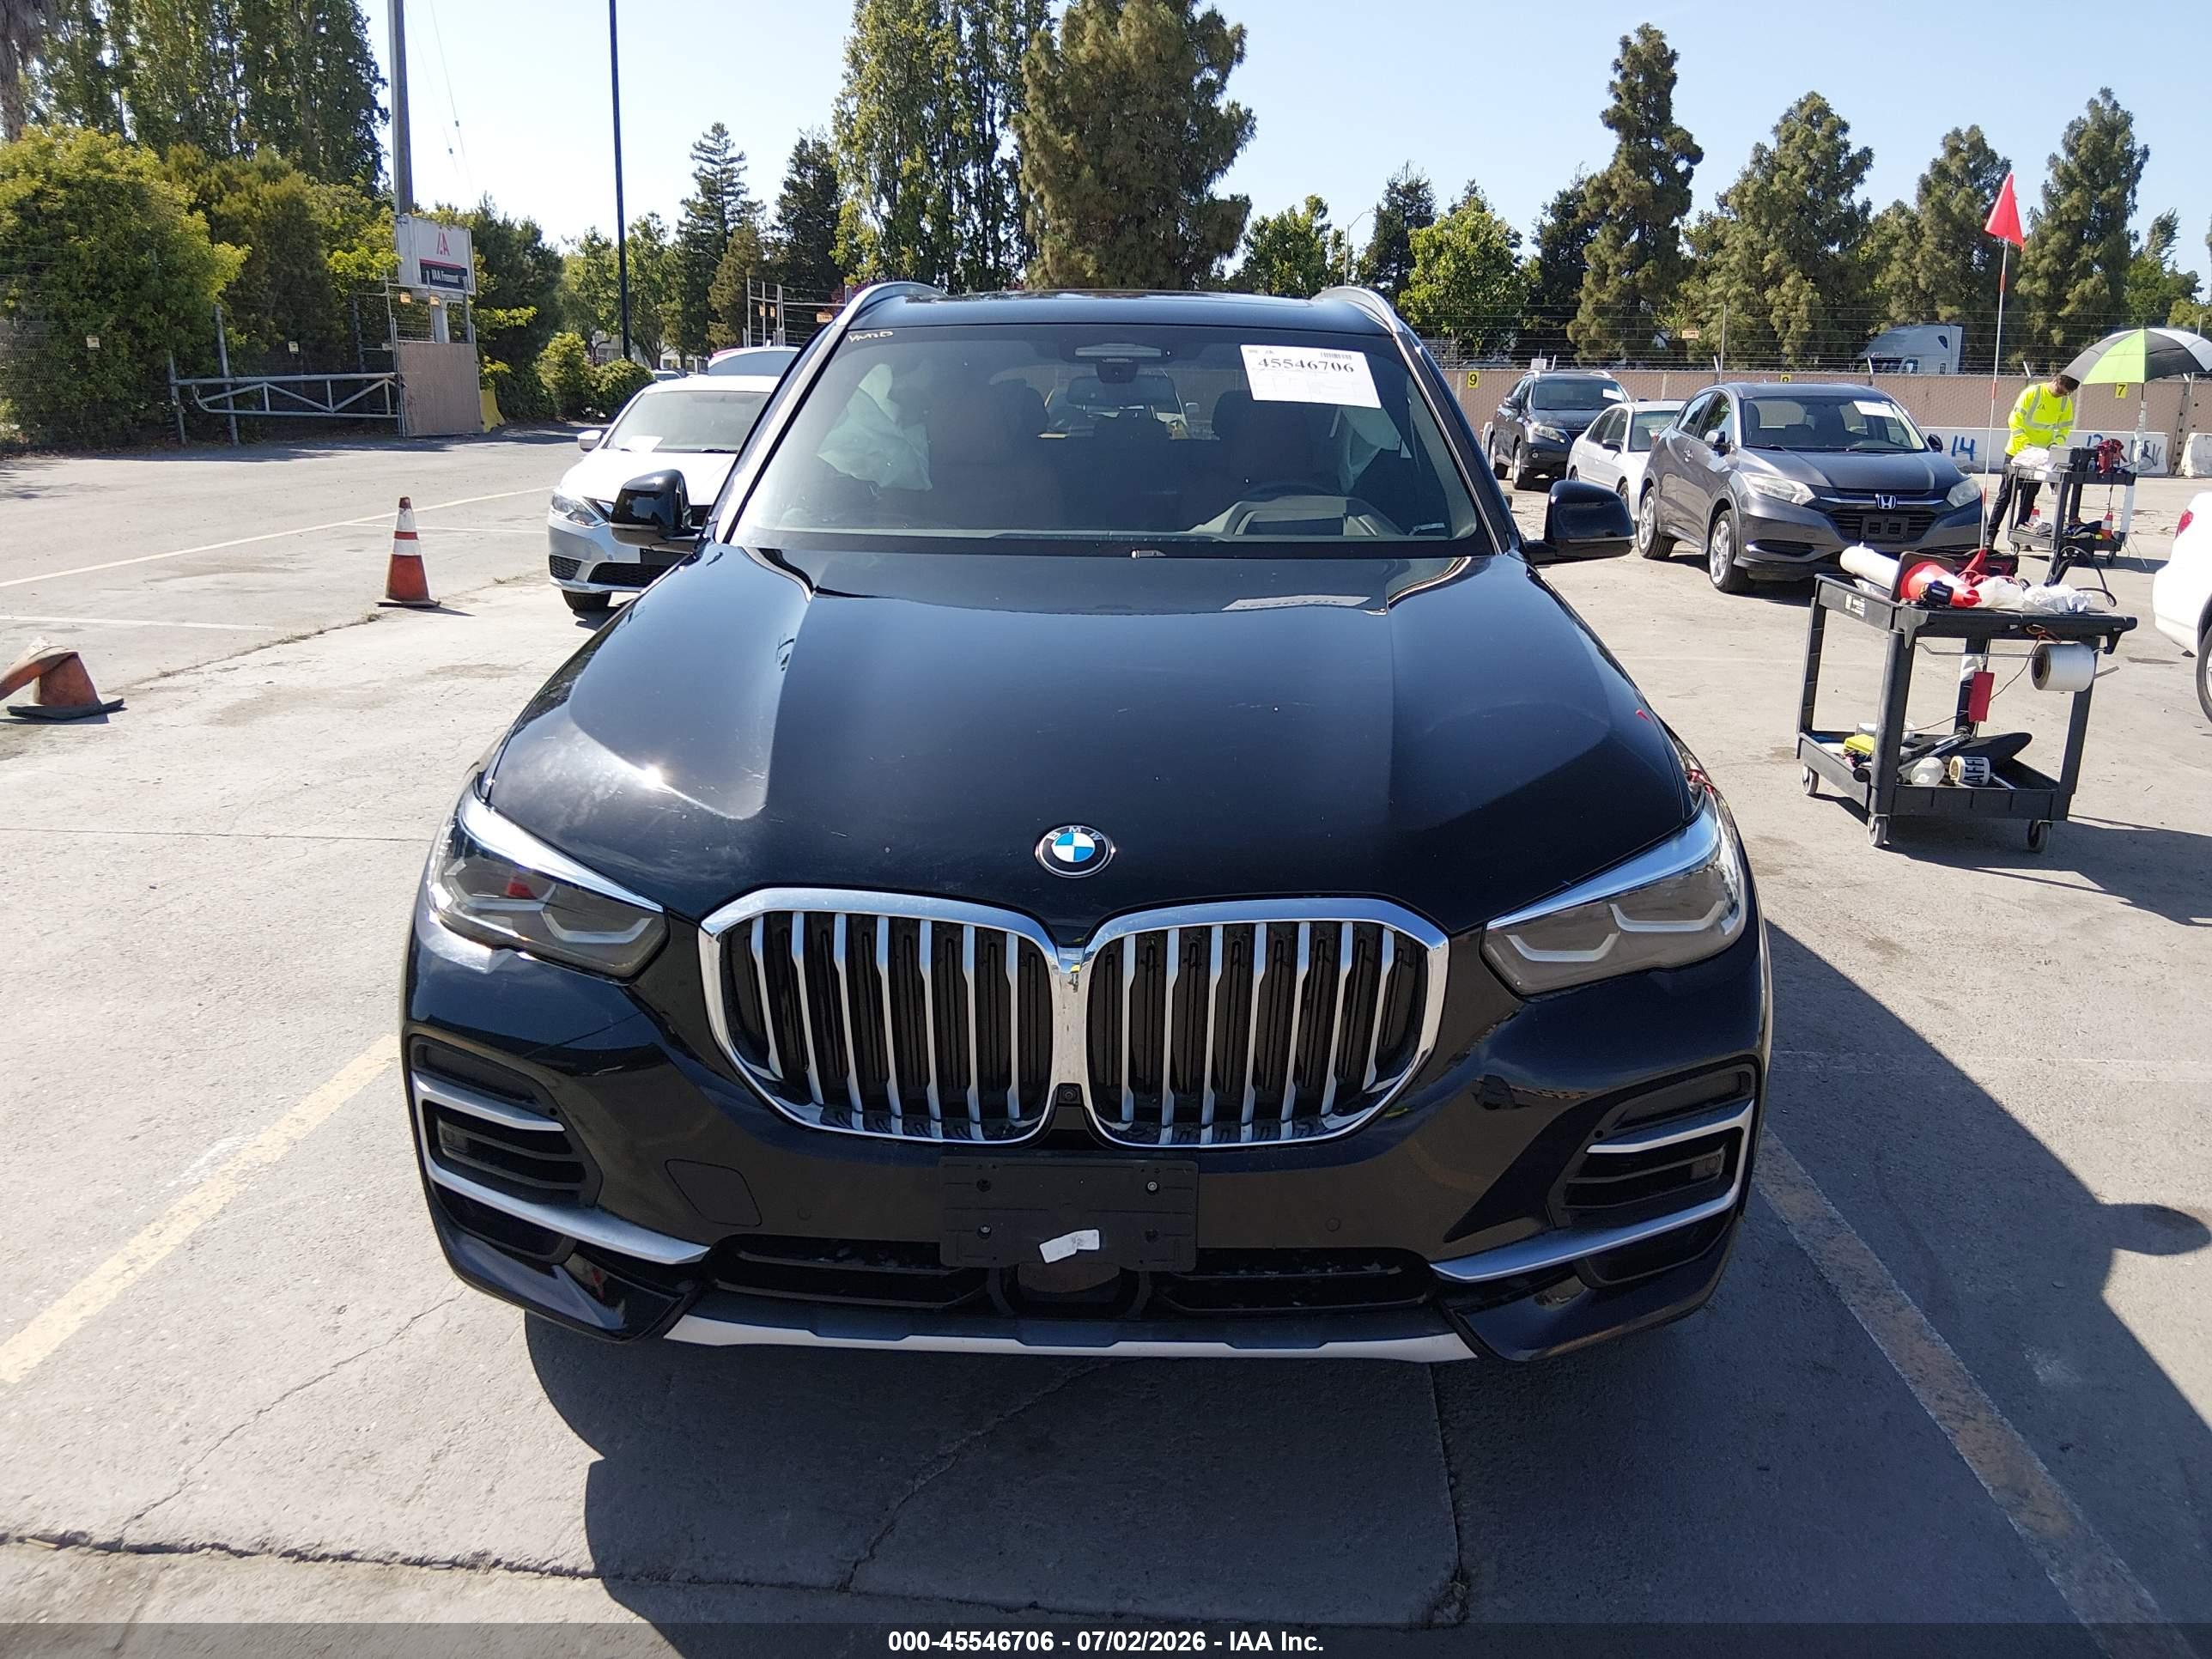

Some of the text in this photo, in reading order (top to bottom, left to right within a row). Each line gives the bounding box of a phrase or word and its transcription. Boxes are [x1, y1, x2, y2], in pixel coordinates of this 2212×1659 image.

[1258, 357, 1354, 374] 45546706
[1469, 374, 1478, 386] 9
[2118, 384, 2126, 397] 7
[1951, 434, 1976, 462] 14
[1964, 757, 1984, 784] AFFI
[1047, 826, 1103, 841] BMW
